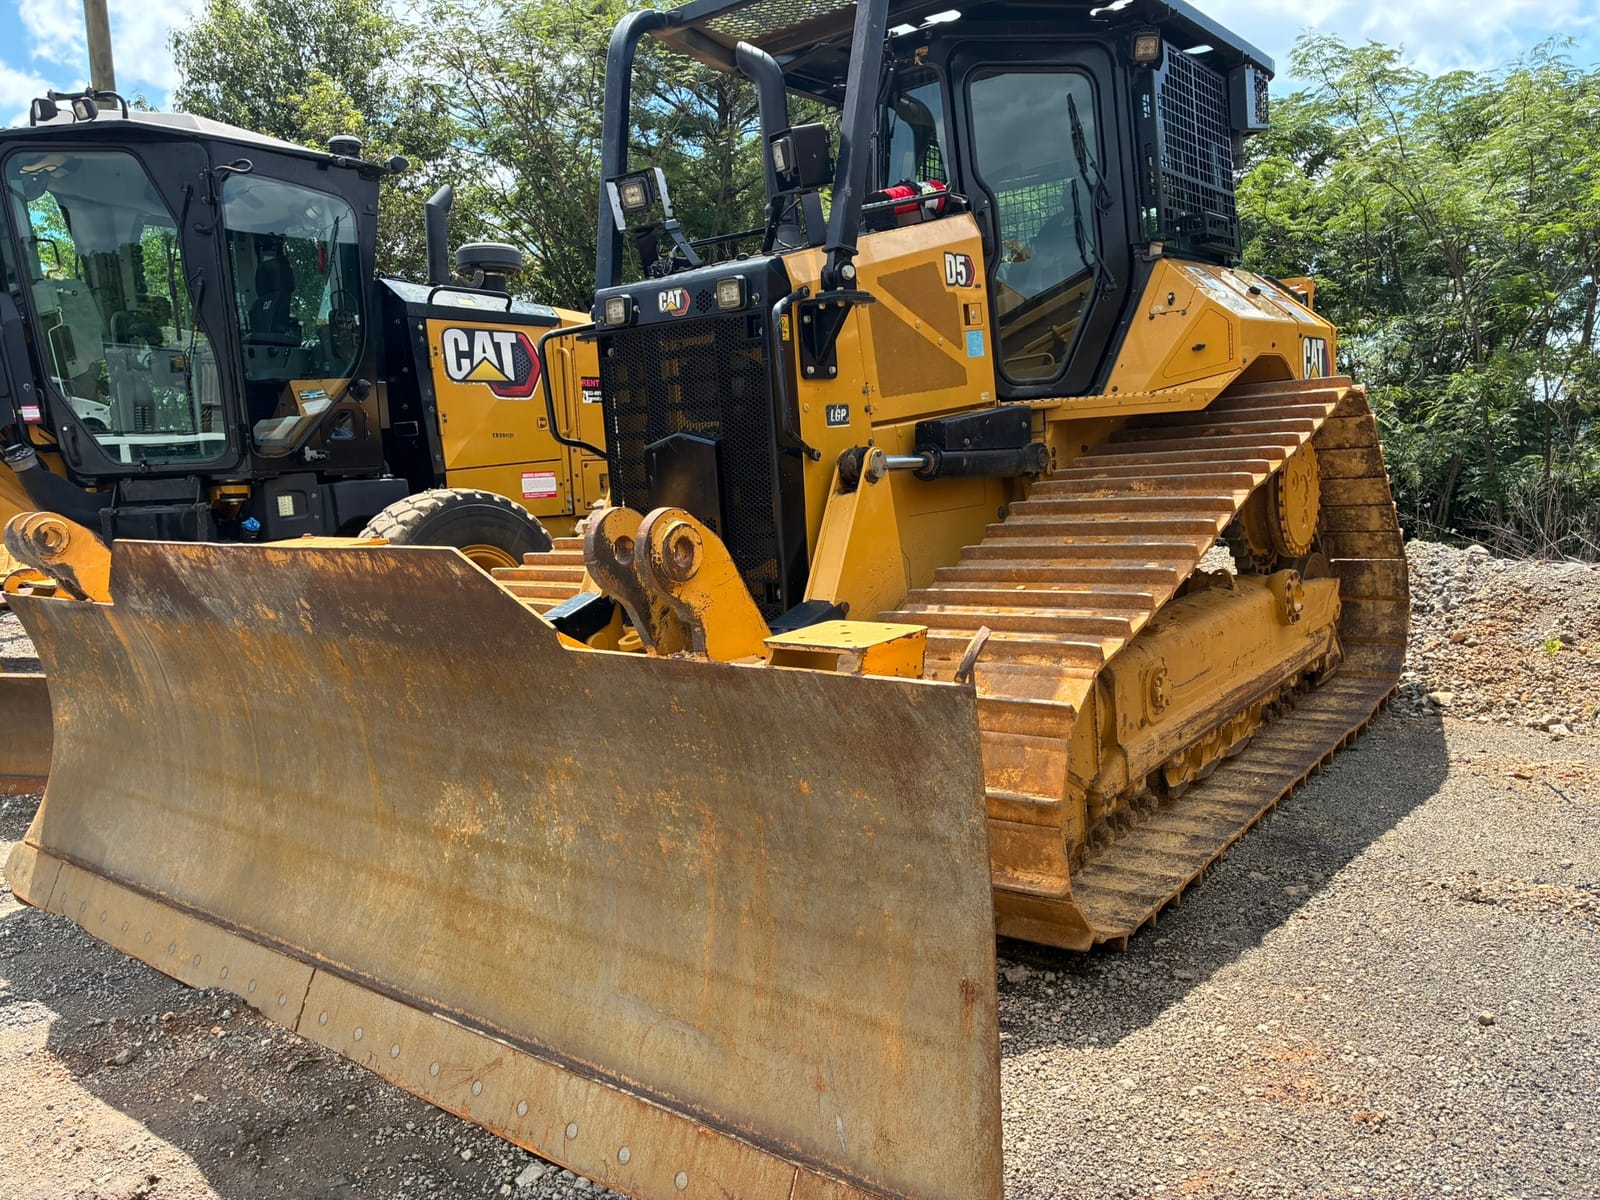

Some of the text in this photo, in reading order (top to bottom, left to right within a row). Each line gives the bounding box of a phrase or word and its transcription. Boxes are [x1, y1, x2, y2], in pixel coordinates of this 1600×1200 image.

[944, 253, 967, 286] D5
[658, 289, 682, 313] CAT
[443, 328, 517, 382] CAT
[1303, 337, 1325, 380] CAT
[830, 408, 847, 422] LGP
